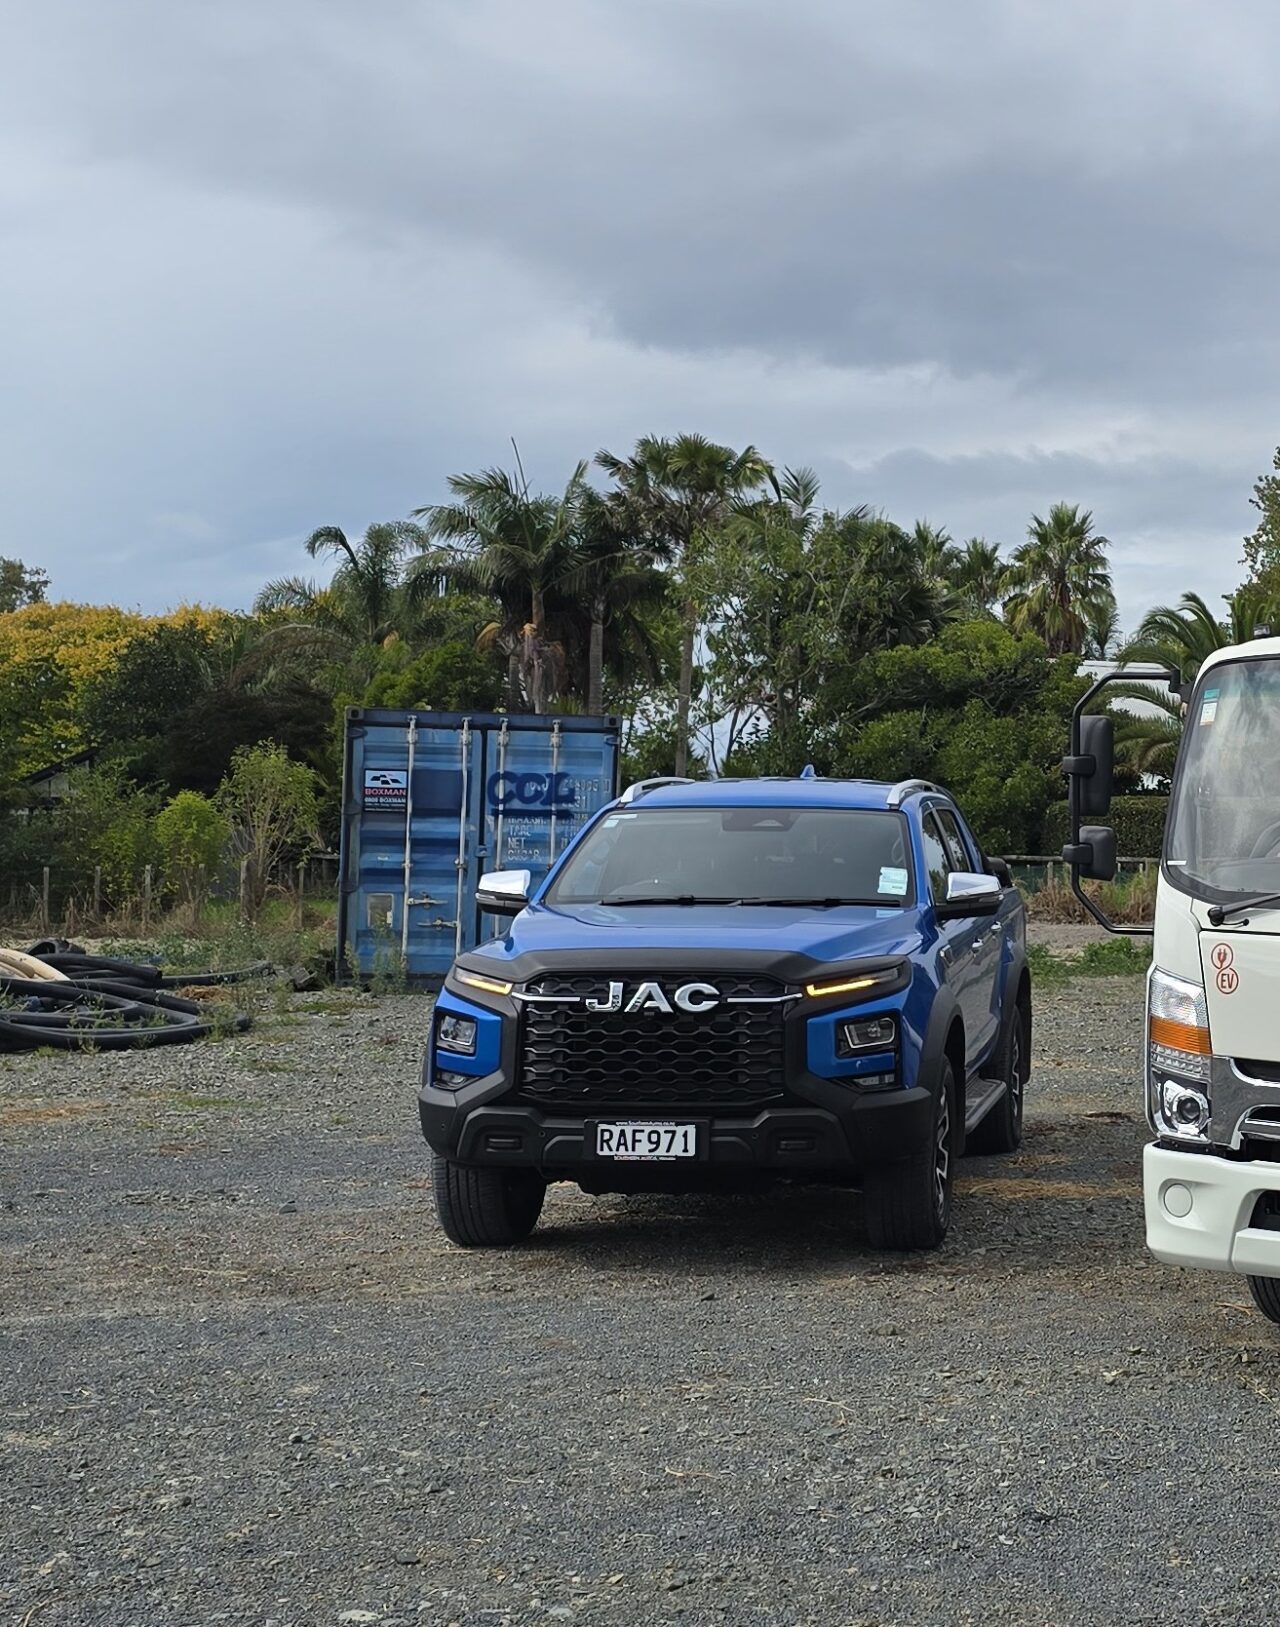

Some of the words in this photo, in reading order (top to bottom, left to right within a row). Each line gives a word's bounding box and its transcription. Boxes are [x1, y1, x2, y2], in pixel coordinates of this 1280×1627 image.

[364, 788, 406, 796] BOXMAN
[508, 837, 526, 849] NET
[1220, 973, 1235, 989] EV
[585, 981, 720, 1013] JAC
[599, 1128, 689, 1153] RAF971
